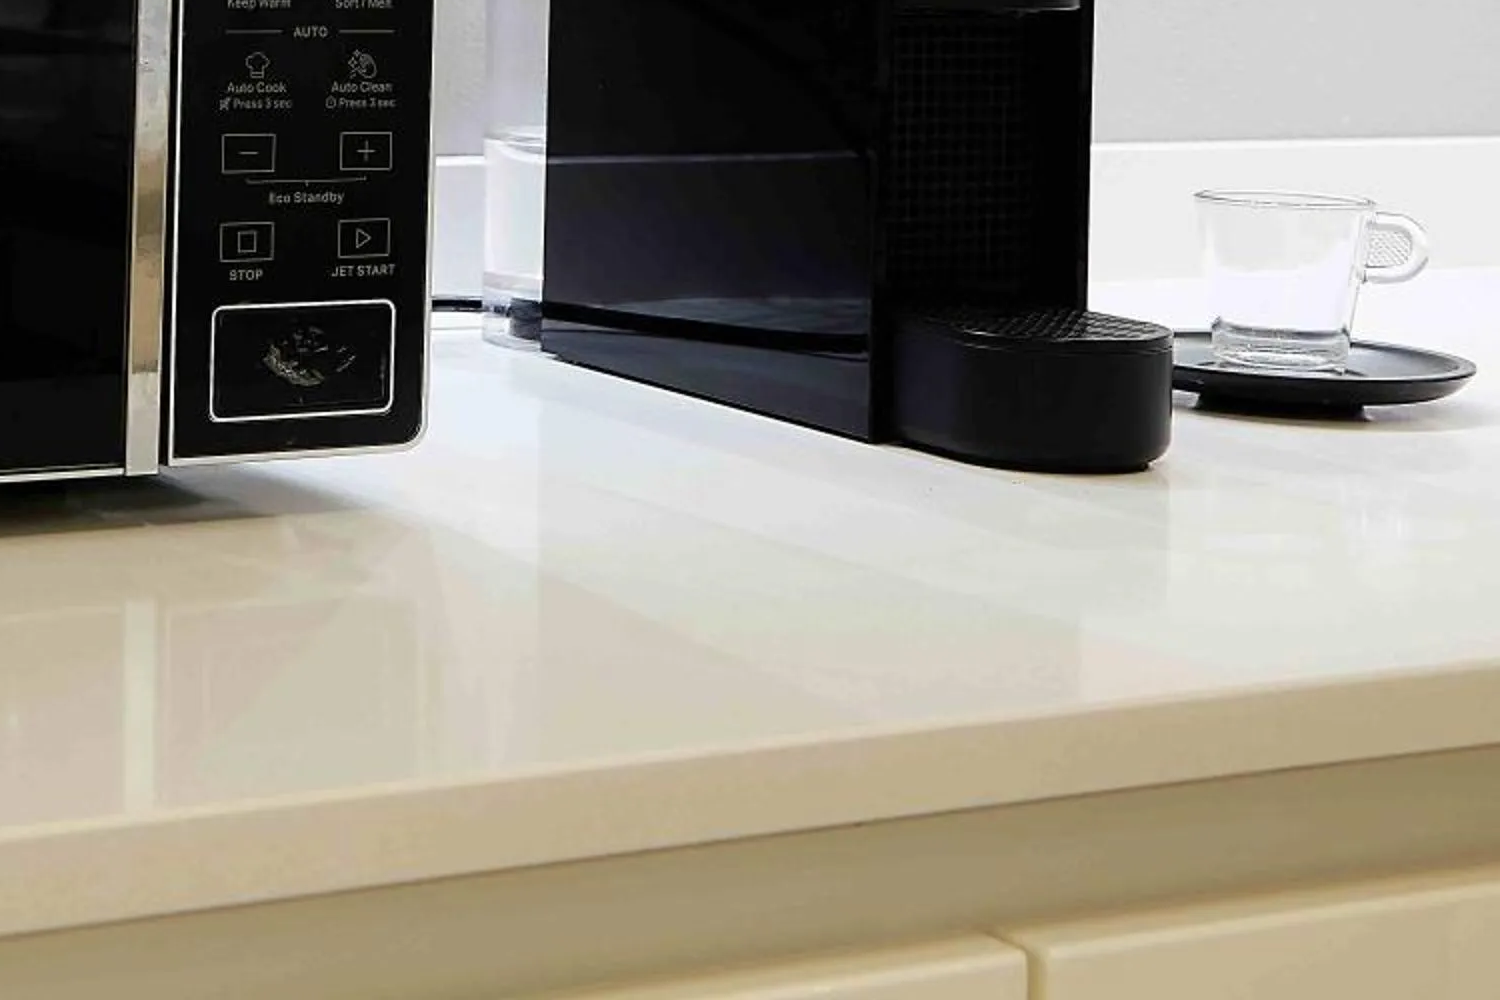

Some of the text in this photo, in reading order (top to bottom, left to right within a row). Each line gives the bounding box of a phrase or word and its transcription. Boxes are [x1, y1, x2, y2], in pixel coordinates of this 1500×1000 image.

[293, 26, 328, 38] AUTO
[227, 82, 287, 93] Auto Cook
[331, 82, 393, 93] Auto Clean
[233, 98, 263, 109] Press
[269, 191, 344, 205] Eco Standby
[229, 269, 263, 281] STOP
[331, 264, 395, 277] JET START
